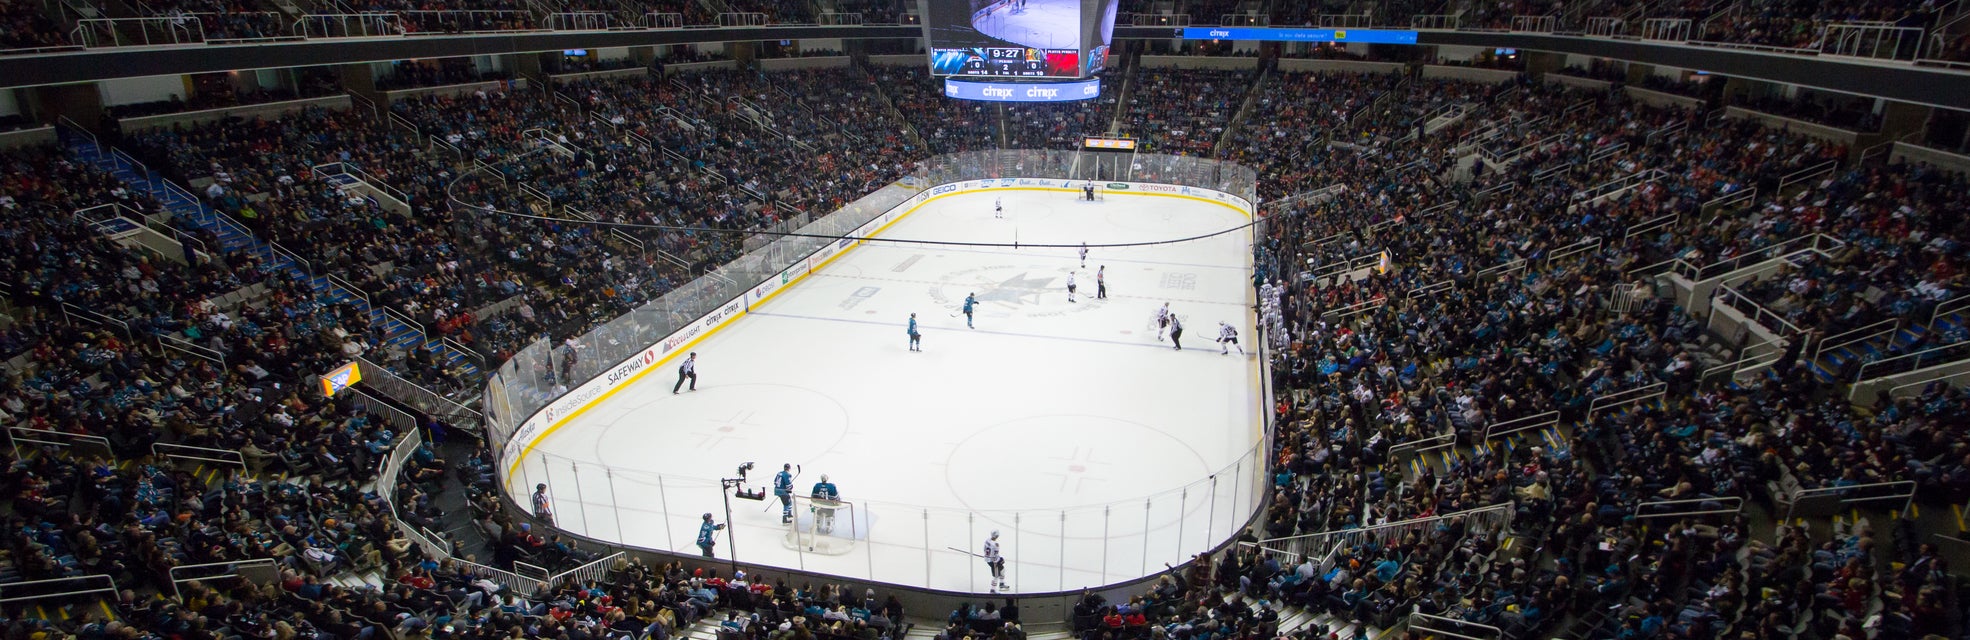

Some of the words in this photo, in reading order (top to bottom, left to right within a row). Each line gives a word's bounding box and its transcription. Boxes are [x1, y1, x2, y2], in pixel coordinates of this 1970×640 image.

[993, 49, 1019, 58] 9:27
[933, 184, 956, 195] GEICO
[607, 355, 644, 385] SAFEWAY
